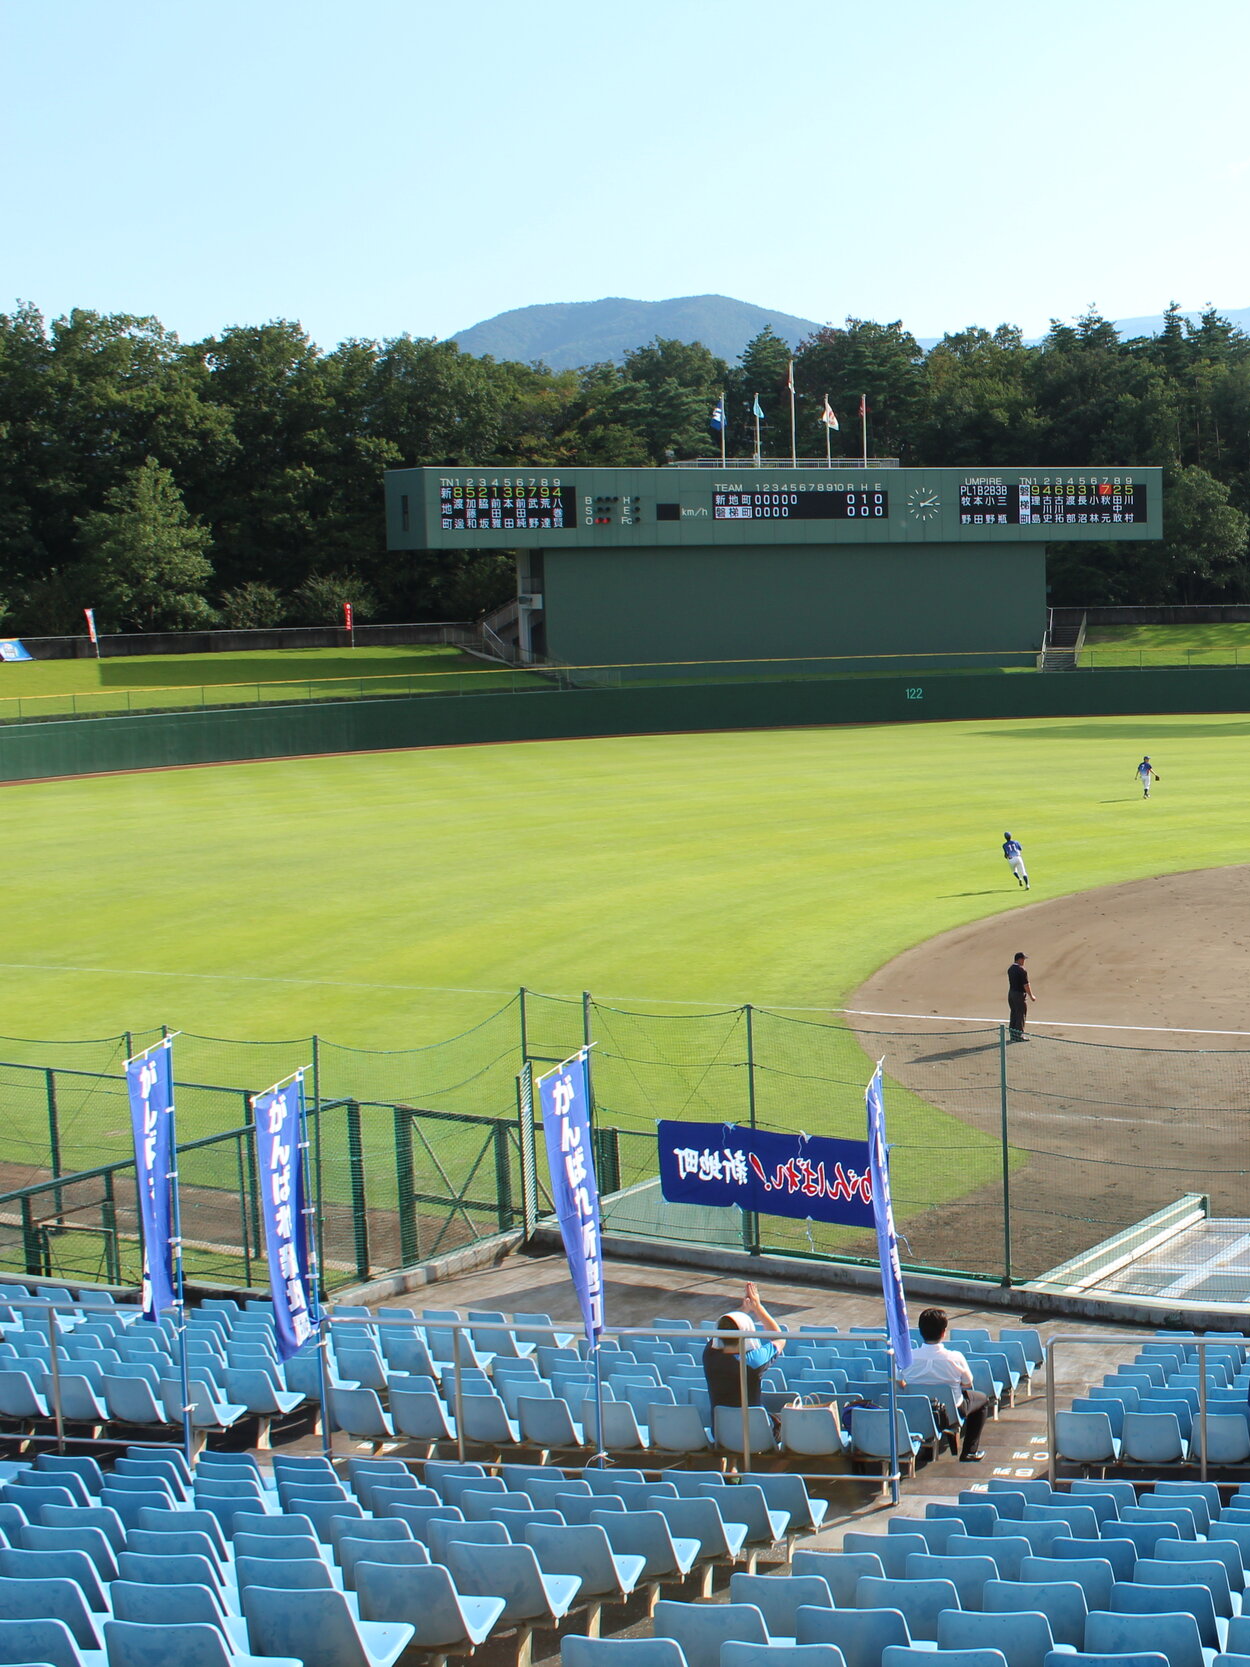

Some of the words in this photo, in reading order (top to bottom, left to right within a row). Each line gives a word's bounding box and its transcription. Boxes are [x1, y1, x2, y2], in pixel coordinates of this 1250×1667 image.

[440, 478, 454, 486] TN
[455, 478, 459, 486] 1
[466, 478, 473, 486] 2
[479, 478, 486, 486] 3
[492, 478, 499, 486] 4
[504, 478, 511, 486] 5
[516, 478, 523, 486] 6
[529, 478, 535, 486] 7
[541, 478, 548, 486] 8
[553, 478, 560, 486] 9
[453, 488, 463, 497] 8
[466, 488, 475, 497] 5
[479, 488, 488, 497] 2
[493, 488, 497, 497] 1
[503, 488, 512, 497] 3
[516, 488, 525, 497] 6
[528, 488, 537, 497] 7
[540, 488, 549, 497] 9
[552, 488, 562, 497] 4
[1031, 486, 1040, 495] 9
[1042, 486, 1052, 495] 4
[1055, 486, 1064, 495] 6
[1066, 486, 1075, 495] 8
[1078, 486, 1087, 495] 3
[1092, 486, 1096, 495] 1
[1101, 486, 1110, 495] 7
[1113, 486, 1122, 495] 2
[1124, 486, 1134, 495] 5
[585, 496, 592, 504] B
[623, 496, 630, 504] H
[716, 495, 751, 505] 新地町
[847, 494, 855, 504] 0
[861, 494, 867, 504] 1
[874, 494, 883, 504] 0
[441, 488, 452, 529] 新地町
[682, 508, 708, 516] km/h
[847, 506, 855, 517] 0
[861, 506, 869, 517] 0
[874, 506, 883, 517] 0
[586, 517, 593, 525] O
[905, 688, 923, 699] 122
